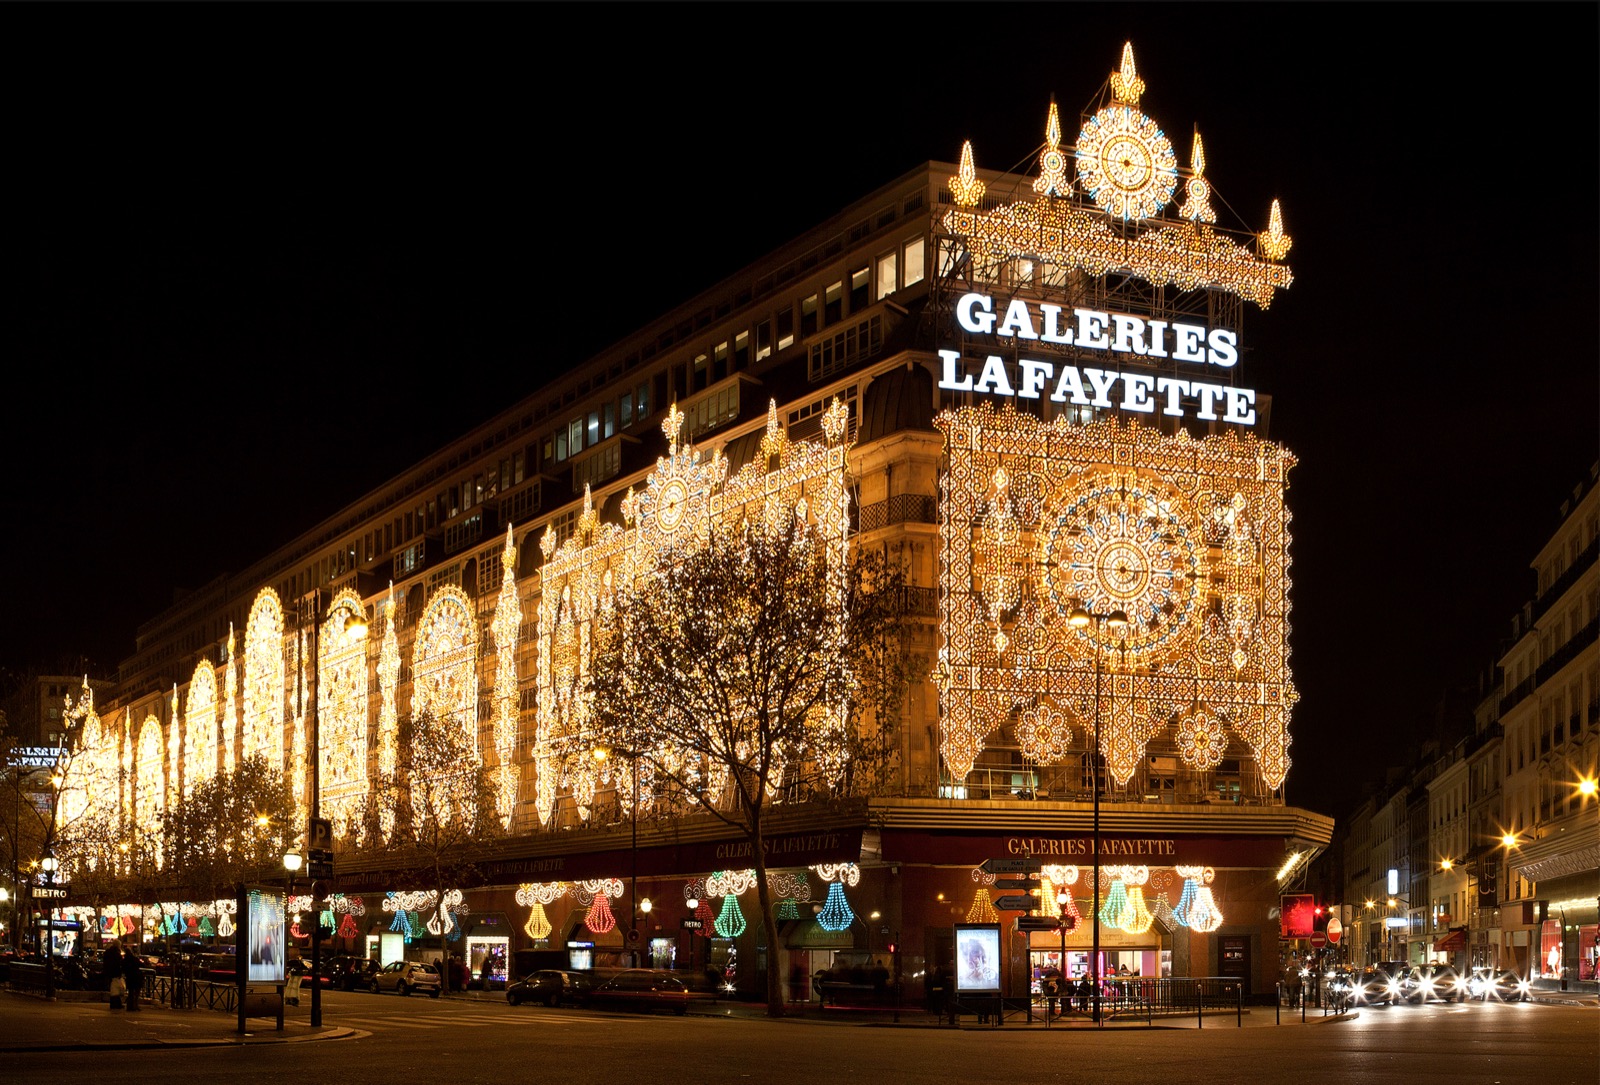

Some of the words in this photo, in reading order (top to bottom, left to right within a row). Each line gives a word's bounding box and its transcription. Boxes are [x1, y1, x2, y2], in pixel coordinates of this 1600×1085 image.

[956, 292, 1239, 368] GALERIES
[938, 349, 1256, 425] LAFAYETTE
[316, 823, 326, 843] P
[772, 833, 840, 854] LAFAYETTE
[1008, 839, 1086, 855] GALERIES
[1091, 839, 1175, 855] LAFAYETTE
